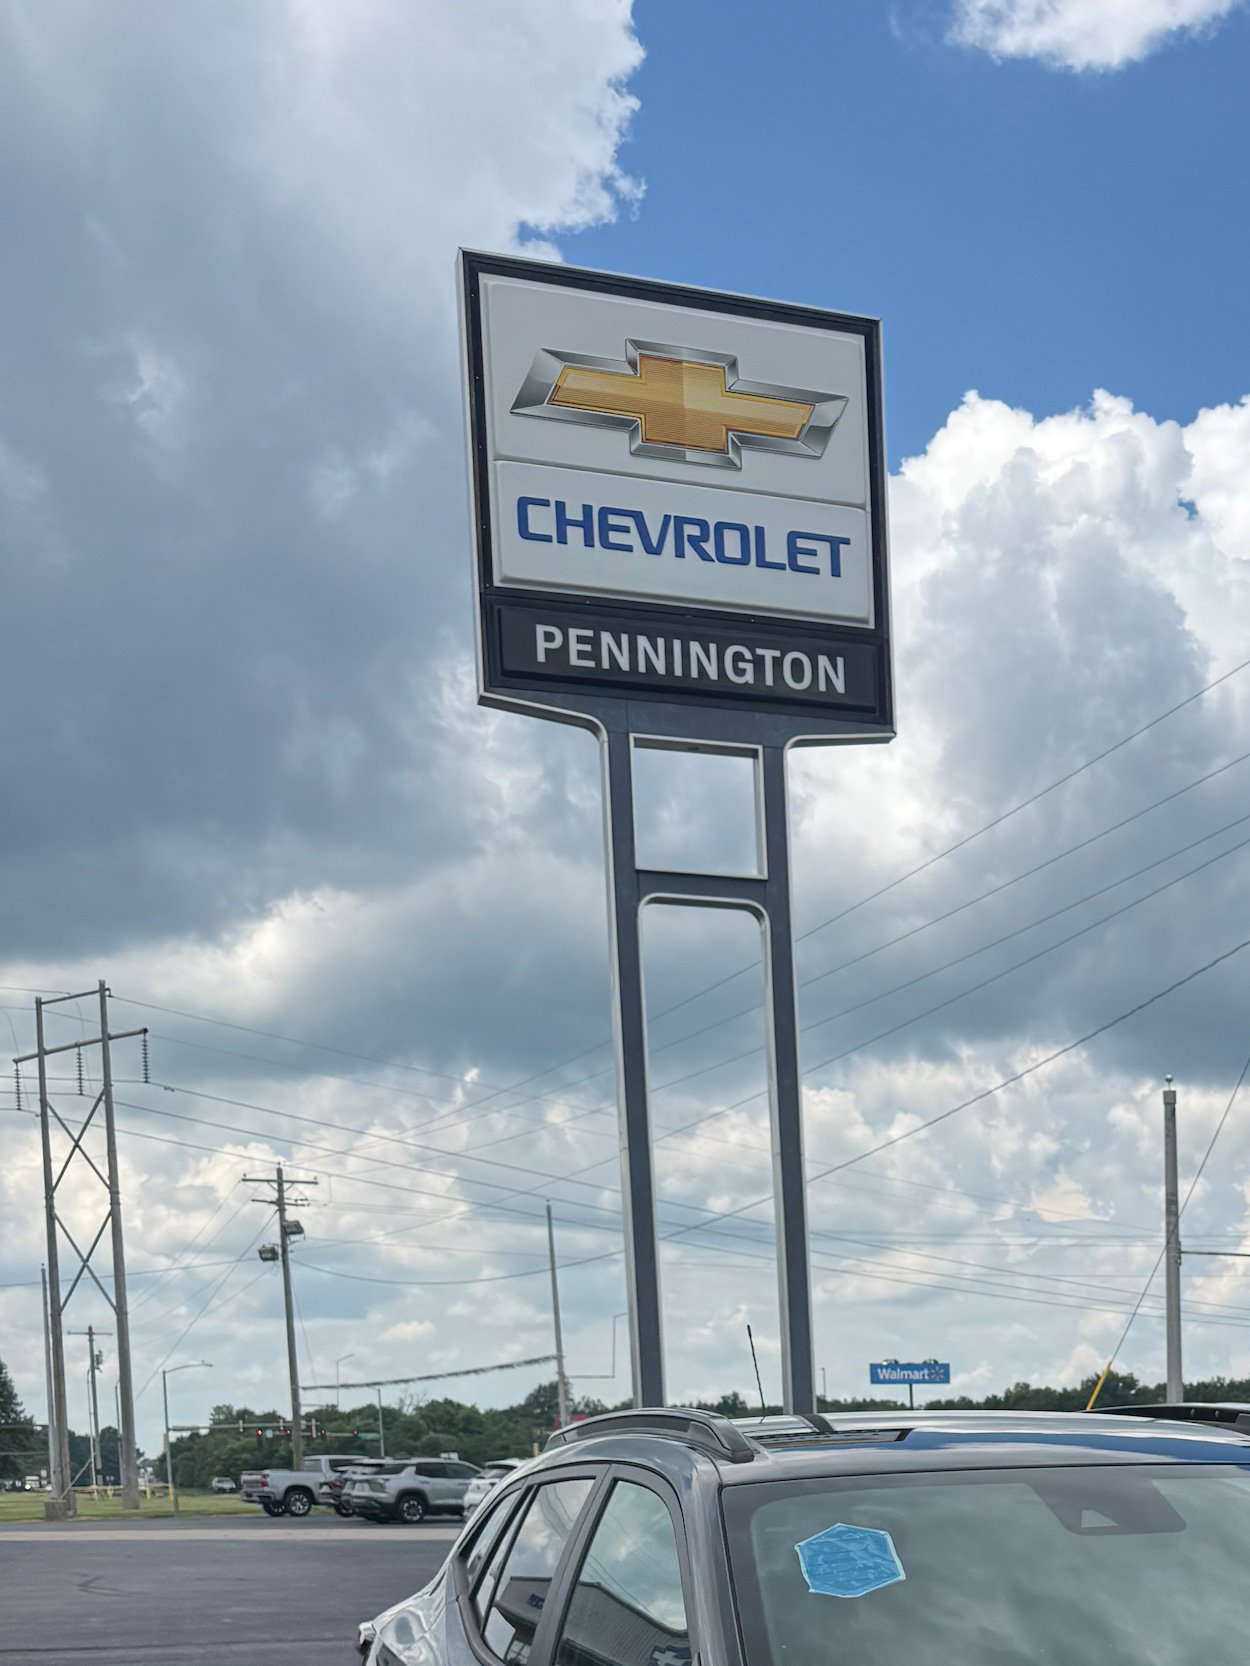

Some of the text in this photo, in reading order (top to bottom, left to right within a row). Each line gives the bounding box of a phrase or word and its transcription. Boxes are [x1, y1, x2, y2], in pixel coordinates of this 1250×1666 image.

[517, 496, 851, 578] CHEVROLET
[535, 624, 846, 694] PENNINGTON
[877, 1367, 930, 1380] Walmart
